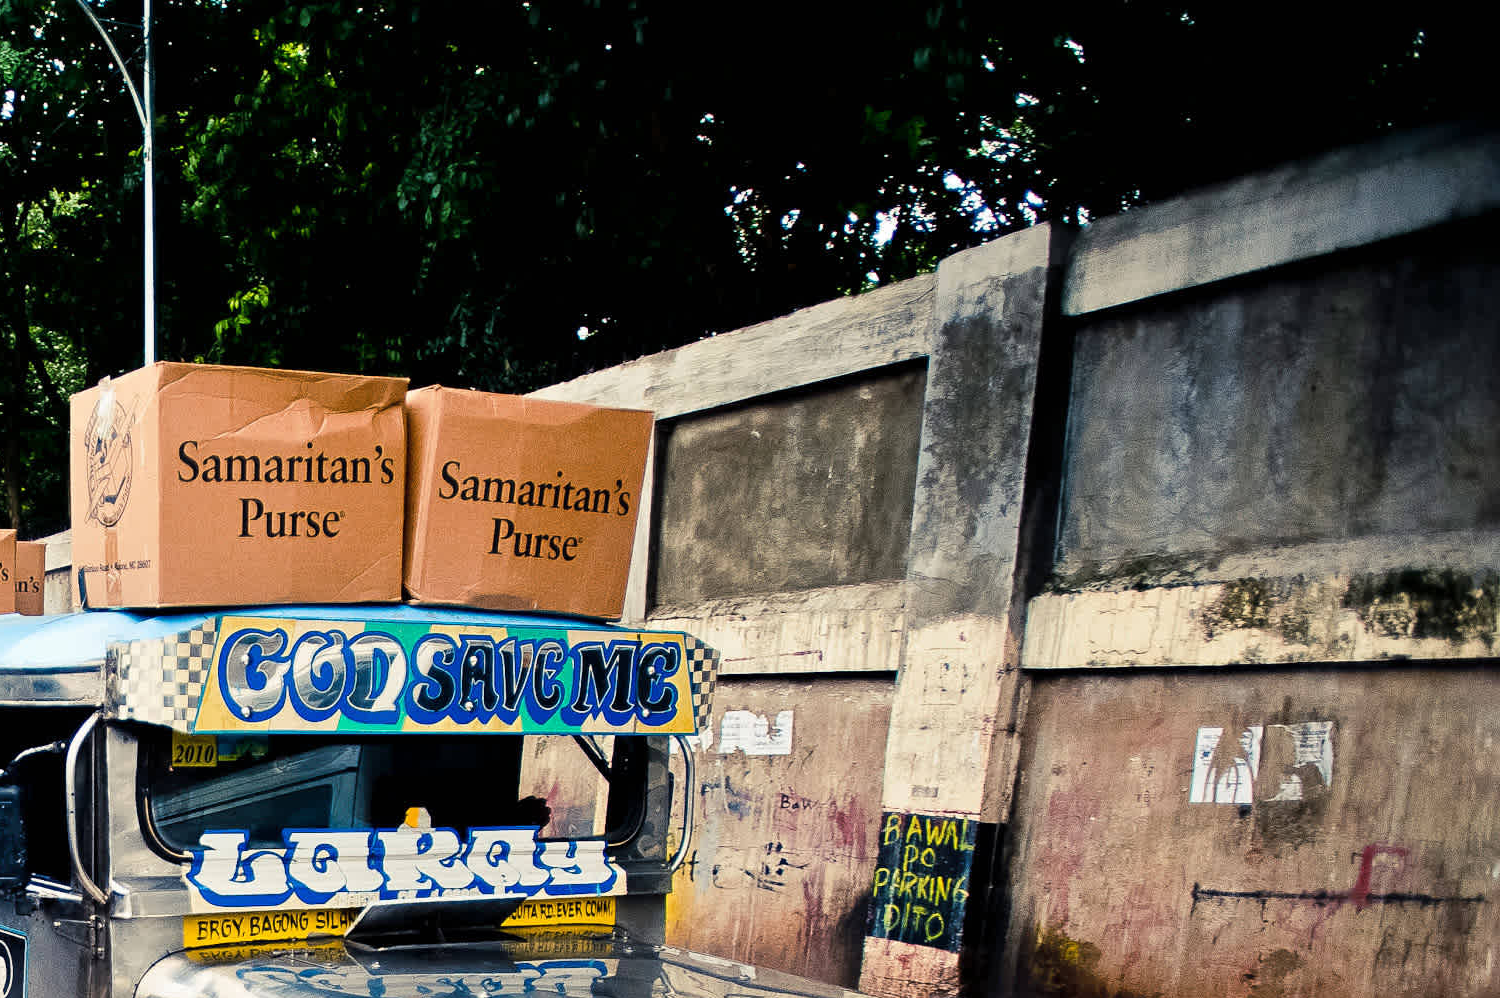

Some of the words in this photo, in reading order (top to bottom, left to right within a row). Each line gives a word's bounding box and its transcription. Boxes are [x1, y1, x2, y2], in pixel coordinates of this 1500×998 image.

[177, 440, 395, 485] Samaritan's
[438, 459, 631, 517] Samaritan's
[238, 498, 340, 538] Purse
[487, 516, 578, 561] Purse
[218, 628, 408, 725] GOD
[410, 635, 566, 724] SAVE
[563, 640, 679, 727] ME
[175, 744, 215, 764] 2010
[883, 814, 976, 851] BAWAL
[903, 844, 936, 872] PO
[873, 867, 970, 906] PARKING
[249, 911, 309, 937] BAGONG
[556, 900, 582, 918] EVER
[883, 903, 945, 942] DITO
